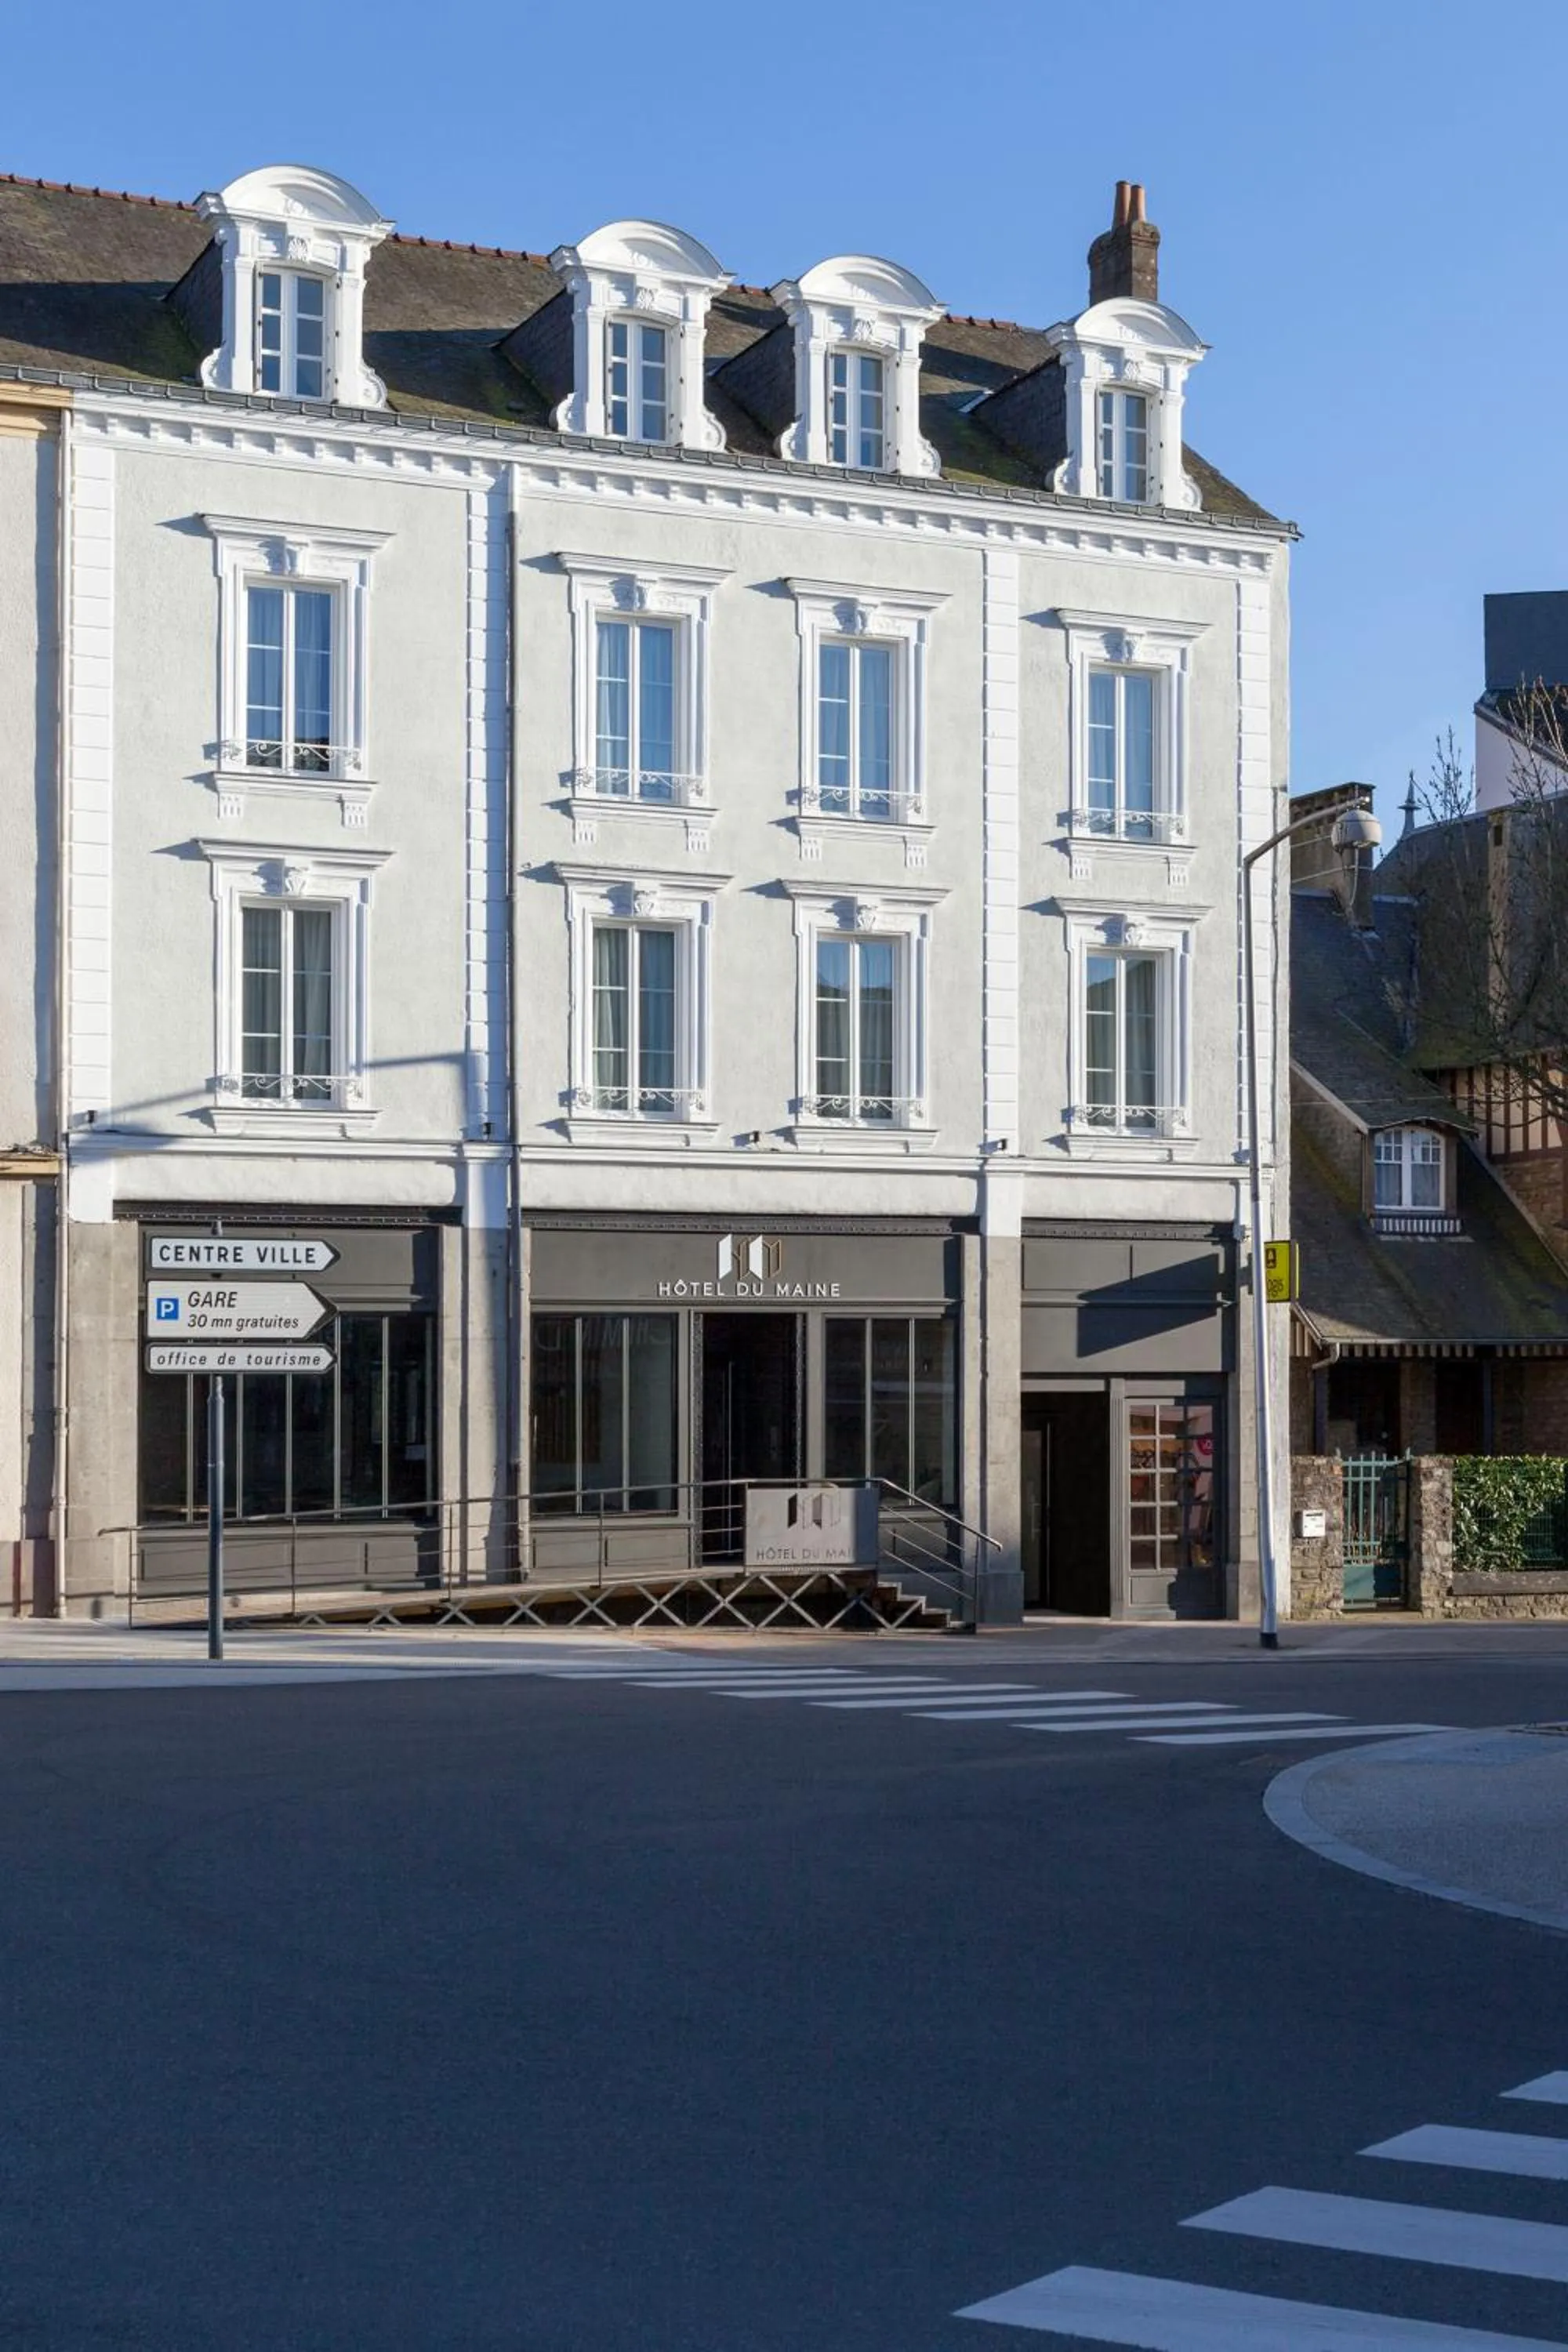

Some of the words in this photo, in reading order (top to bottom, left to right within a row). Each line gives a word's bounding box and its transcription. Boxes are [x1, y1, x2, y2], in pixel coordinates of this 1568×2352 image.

[158, 1244, 244, 1263] CENTRE
[256, 1247, 316, 1264] VILLE
[659, 1279, 725, 1297] HÔTEL
[736, 1282, 764, 1297] DU
[775, 1283, 841, 1298] MAINE
[187, 1291, 238, 1308] GARE
[160, 1301, 174, 1318] P
[187, 1314, 208, 1329] 30
[210, 1318, 233, 1329] mn
[235, 1315, 299, 1332] gratuites
[157, 1352, 207, 1366] office
[216, 1352, 236, 1366] de
[246, 1352, 321, 1366] tourisme
[756, 1547, 797, 1560] HÔTEL
[802, 1548, 819, 1560] DU
[826, 1548, 858, 1559] MAI
